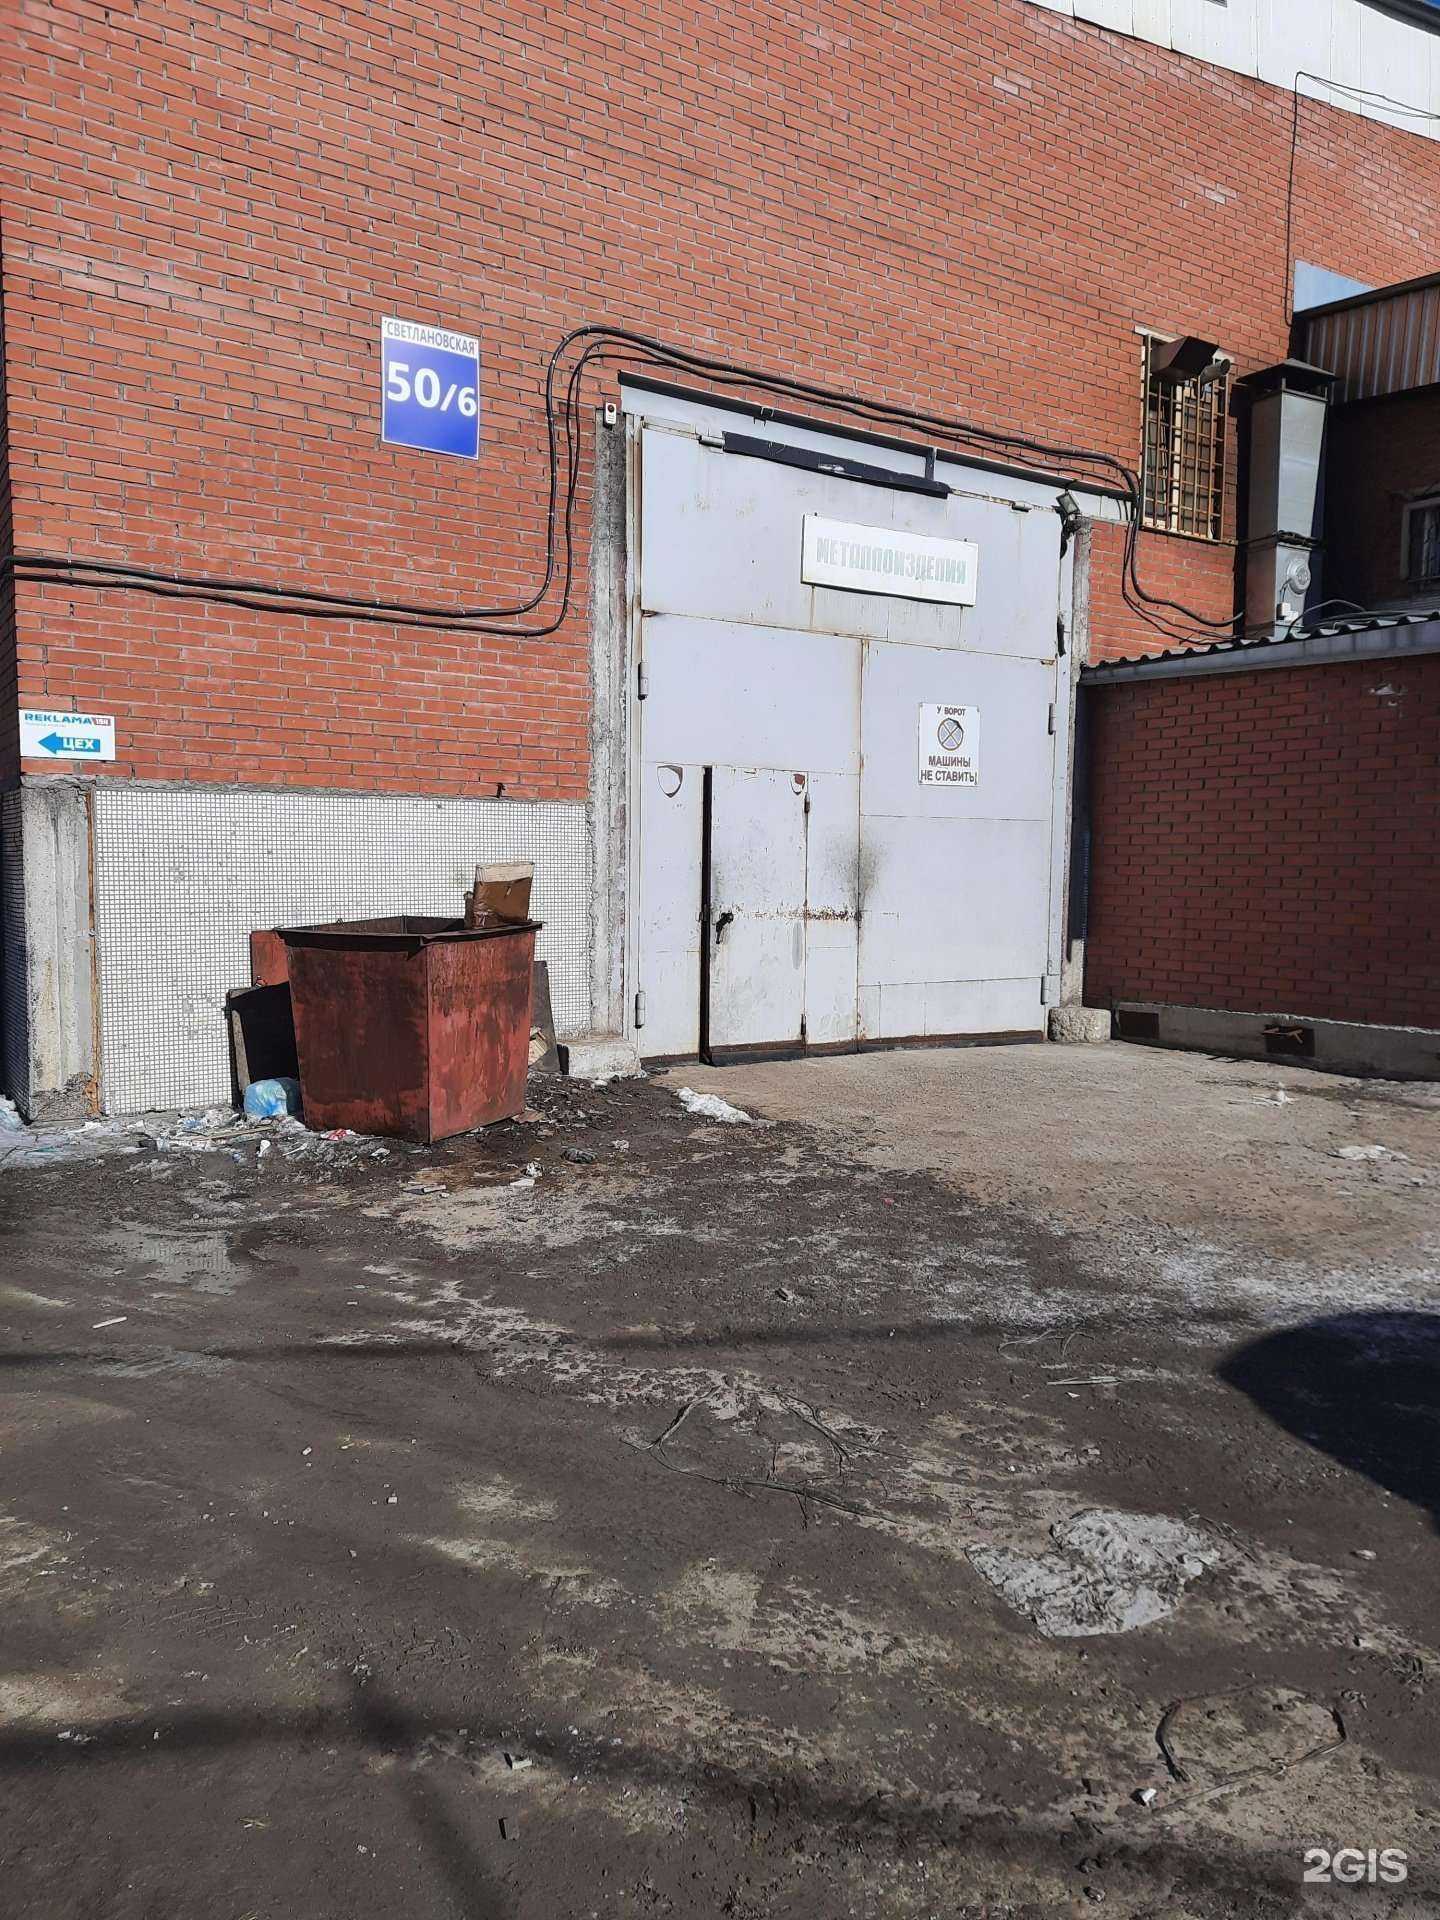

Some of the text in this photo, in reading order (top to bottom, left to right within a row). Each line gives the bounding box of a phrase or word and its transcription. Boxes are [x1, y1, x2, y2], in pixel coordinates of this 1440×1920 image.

[386, 321, 475, 353] СВЕТЛАНОВСКАЯ
[387, 360, 477, 417] 50/6
[817, 537, 967, 584] МЕТАЛЛОИЗДЕЛИЯ
[936, 706, 966, 716] У ВОРОТ
[24, 713, 92, 725] REKLAMA
[63, 737, 94, 750] ЦЕХ
[928, 755, 971, 767] МАШИНЫ
[920, 770, 933, 780] НЕ
